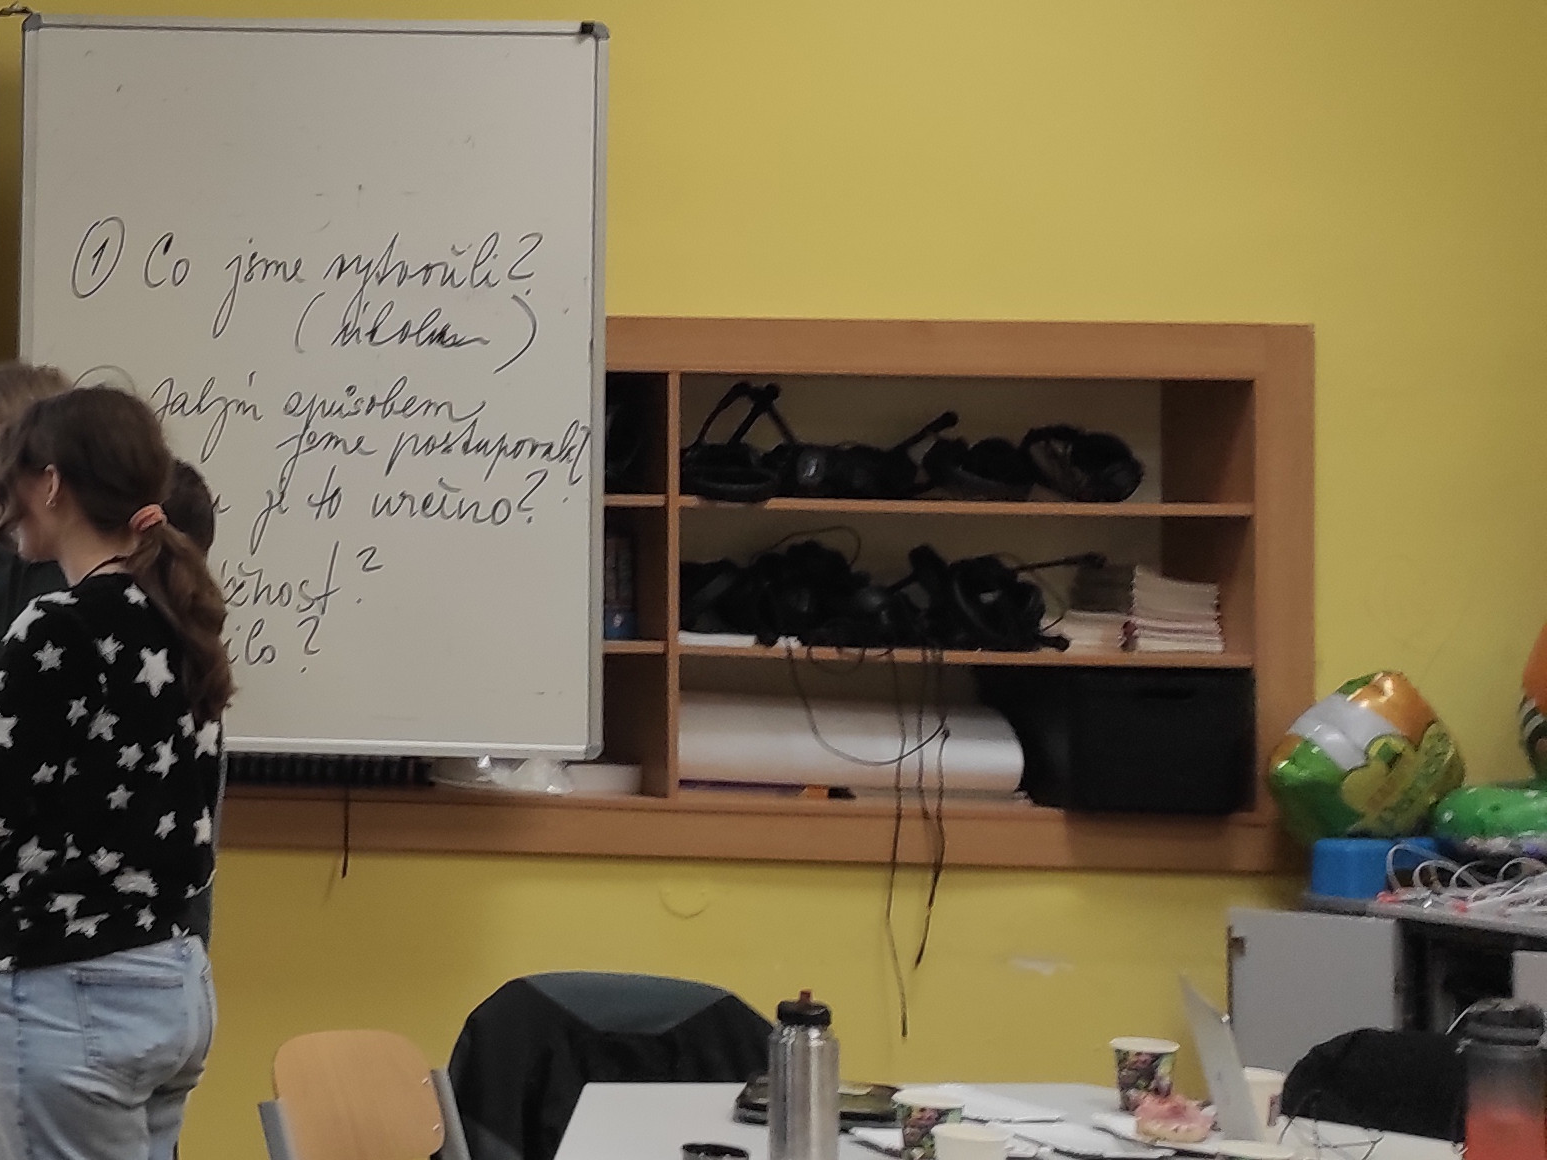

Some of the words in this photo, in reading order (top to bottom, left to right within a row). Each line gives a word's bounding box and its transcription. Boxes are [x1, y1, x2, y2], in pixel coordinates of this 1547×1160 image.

[143, 231, 191, 289] Co
[212, 237, 307, 340] jsme
[307, 464, 342, 521] to
